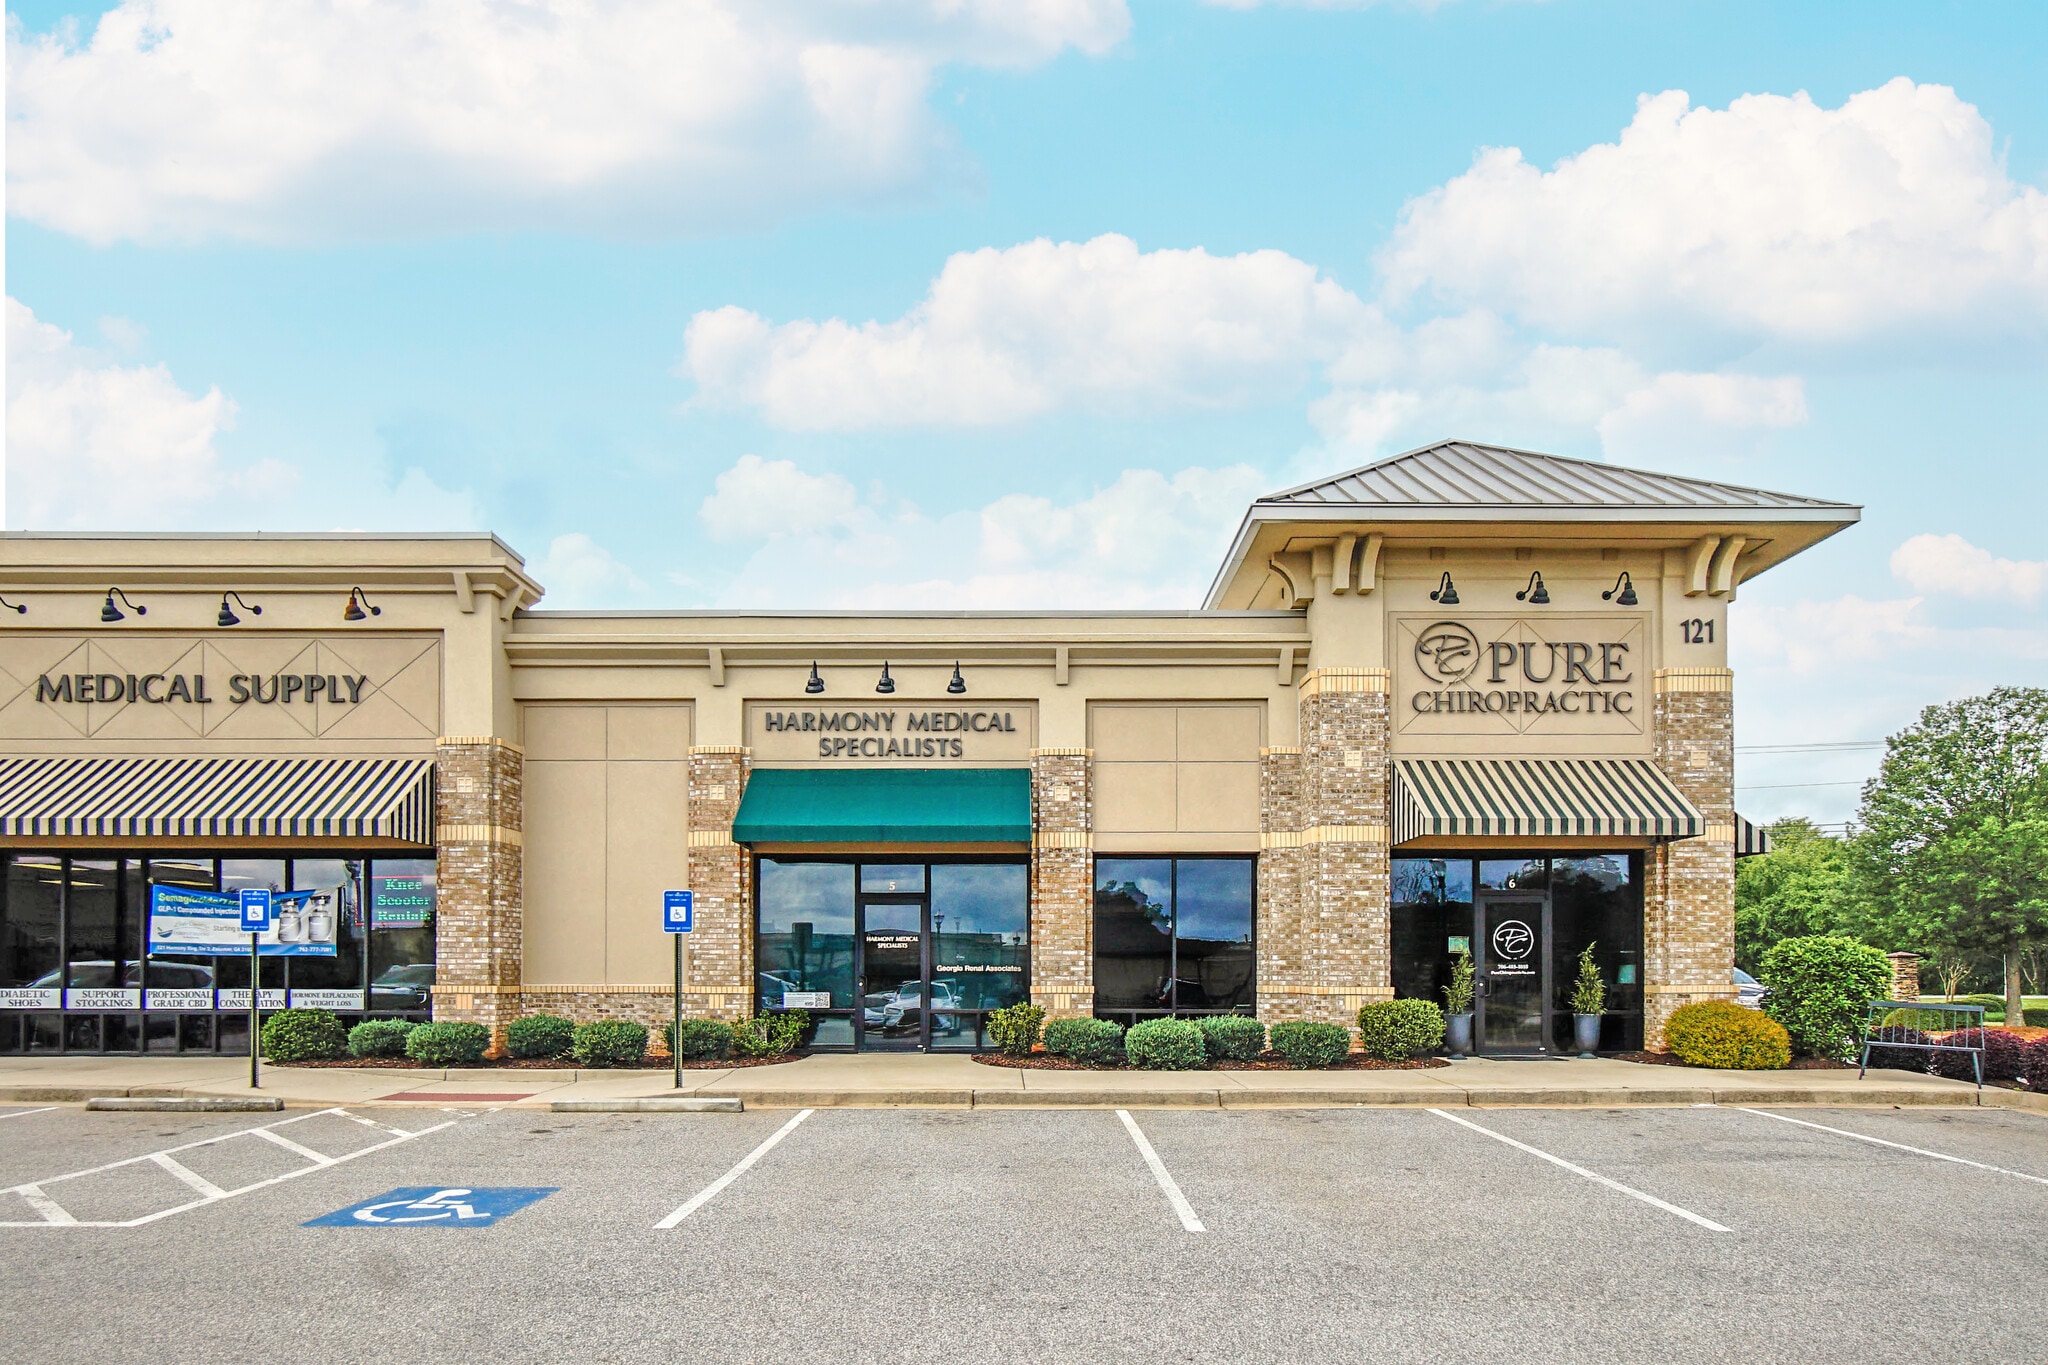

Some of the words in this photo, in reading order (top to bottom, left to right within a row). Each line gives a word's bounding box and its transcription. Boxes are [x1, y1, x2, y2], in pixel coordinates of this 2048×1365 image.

[1680, 618, 1714, 644] 121
[1487, 640, 1633, 684] PURE
[35, 673, 212, 704] MEDICAL
[228, 673, 367, 704] SUPPLY
[1411, 690, 1634, 714] CHIROPRACTIC
[765, 711, 895, 734] HARMONY
[906, 712, 1017, 734] MEDICAL
[819, 737, 964, 758] SPECIALISTS
[385, 878, 423, 890] Knee
[888, 881, 896, 891] 5
[1508, 878, 1516, 889] 6
[377, 894, 431, 906] Scooter
[936, 965, 963, 973] Georgia
[964, 965, 984, 973] Renal
[985, 965, 1022, 973] Associates
[0, 990, 50, 998] DIABETIC
[82, 991, 127, 999] SUPPORT
[148, 991, 212, 999] PROFESSIONAL
[232, 991, 273, 999] THEAPY
[8, 999, 42, 1007] SHOES
[75, 1000, 133, 1008] STOCKINGS
[153, 1000, 184, 1008] GRADE
[188, 1000, 207, 1008] CBD
[219, 999, 285, 1008] CONSULATION
